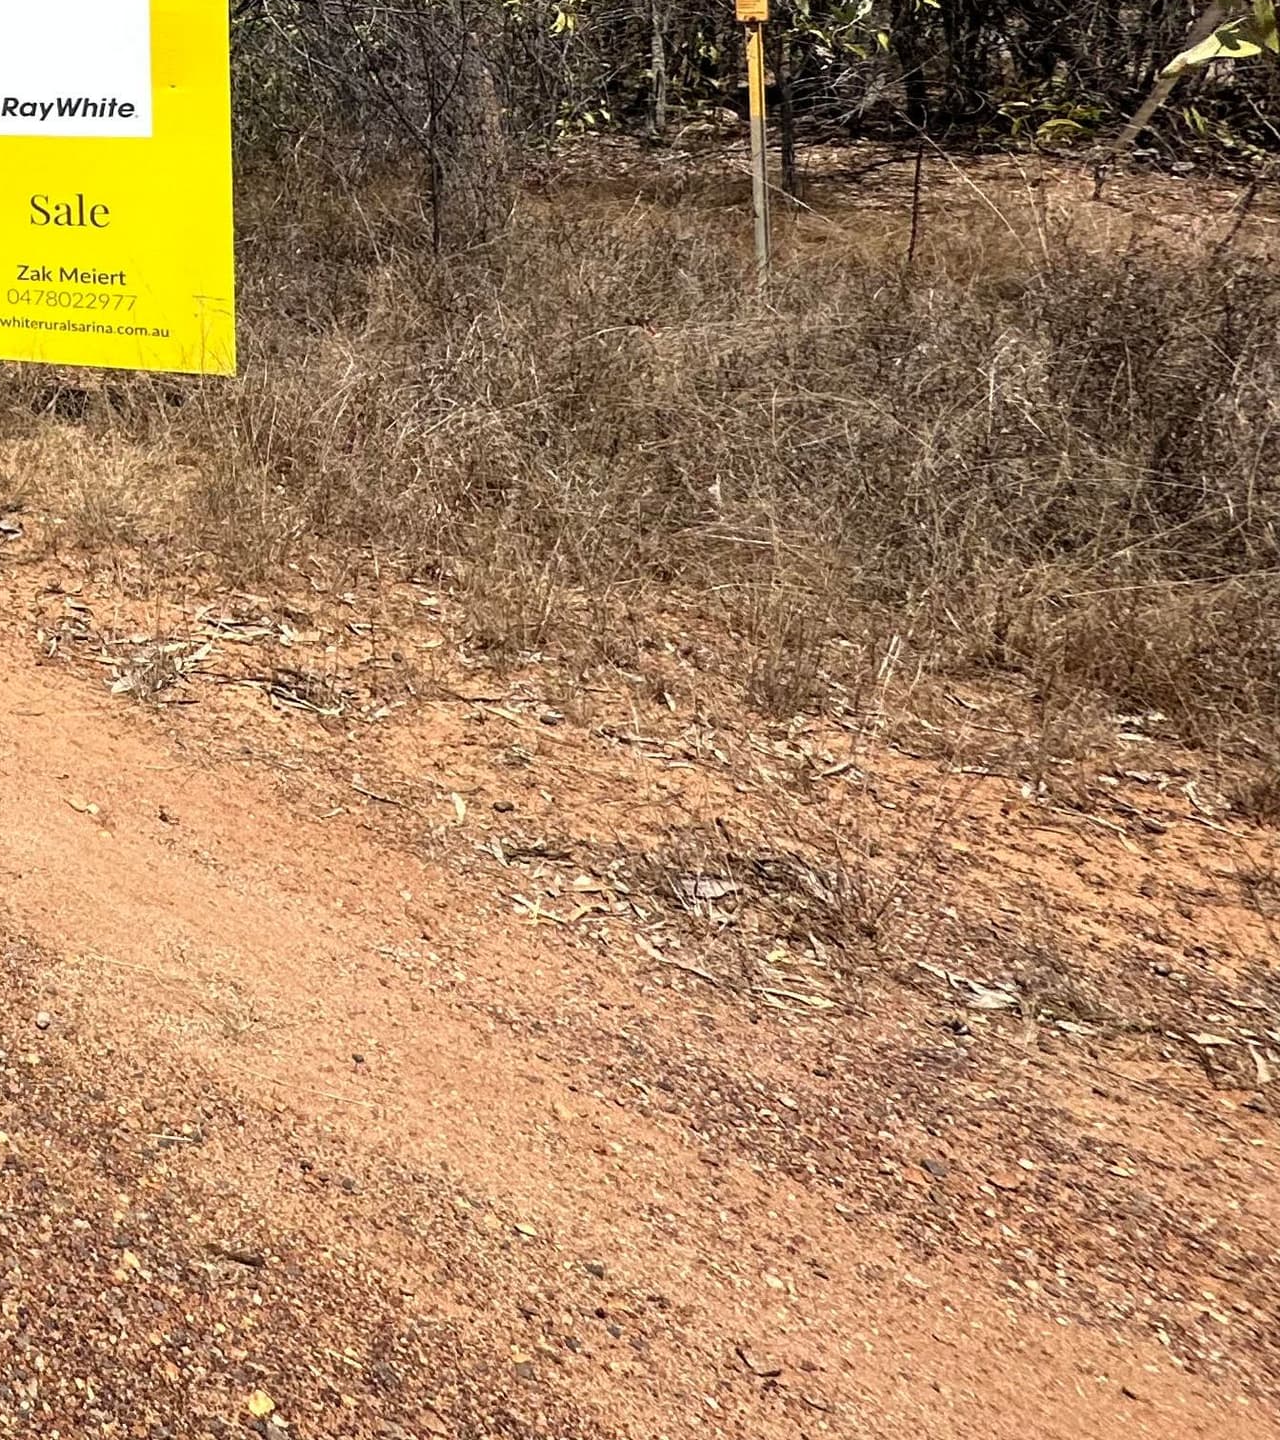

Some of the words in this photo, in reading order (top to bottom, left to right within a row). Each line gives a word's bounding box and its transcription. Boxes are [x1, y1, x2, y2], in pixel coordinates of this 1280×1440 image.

[30, 193, 110, 228] Sale
[17, 264, 53, 282] Zak
[59, 267, 127, 286] Meiert
[7, 288, 138, 311] 0478022977
